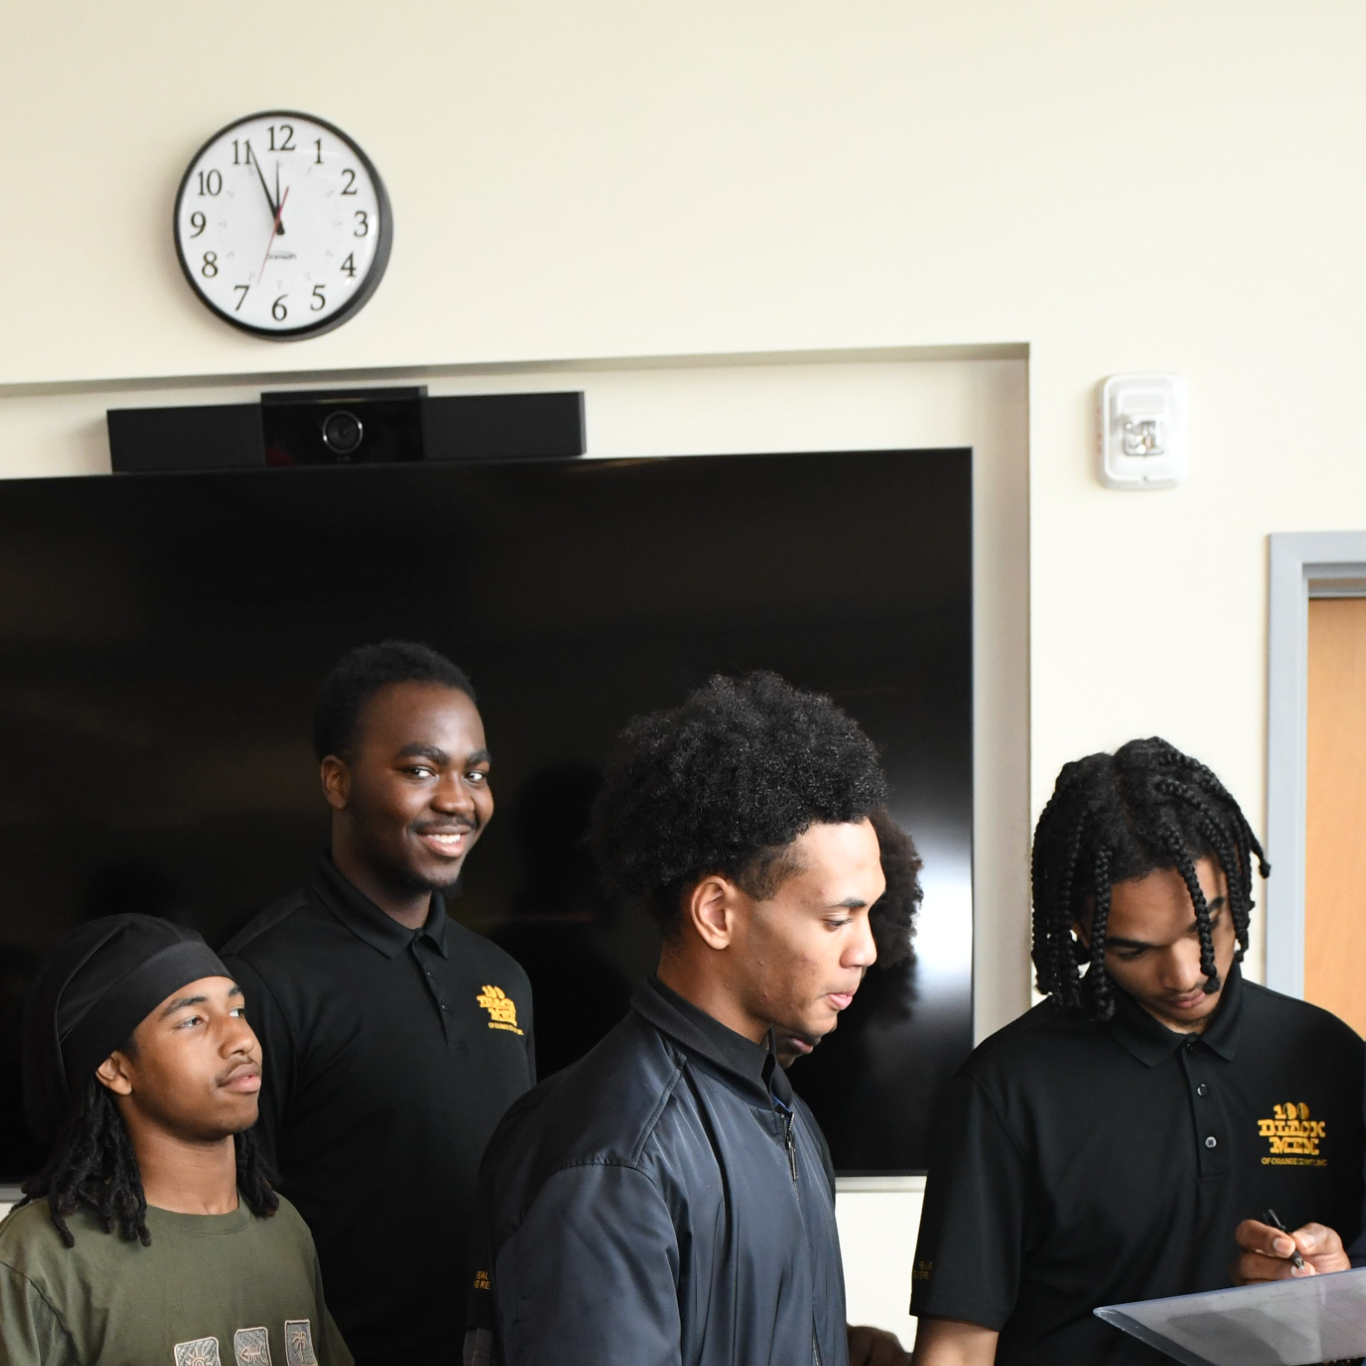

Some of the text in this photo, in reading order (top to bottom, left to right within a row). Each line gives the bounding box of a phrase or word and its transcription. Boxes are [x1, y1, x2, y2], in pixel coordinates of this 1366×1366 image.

[232, 139, 252, 165] 11
[266, 125, 296, 152] 12
[314, 138, 324, 164] 1
[198, 169, 222, 197] 10
[340, 168, 358, 195] 2
[190, 211, 206, 238] 9
[353, 210, 369, 237] 3
[201, 251, 218, 278] 8
[340, 251, 356, 277] 4
[233, 285, 250, 311] 7
[271, 294, 288, 321] 6
[310, 284, 326, 311] 5
[1273, 1101, 1310, 1120] 100
[1257, 1119, 1326, 1138] BLACK
[1269, 1136, 1320, 1155] MEN
